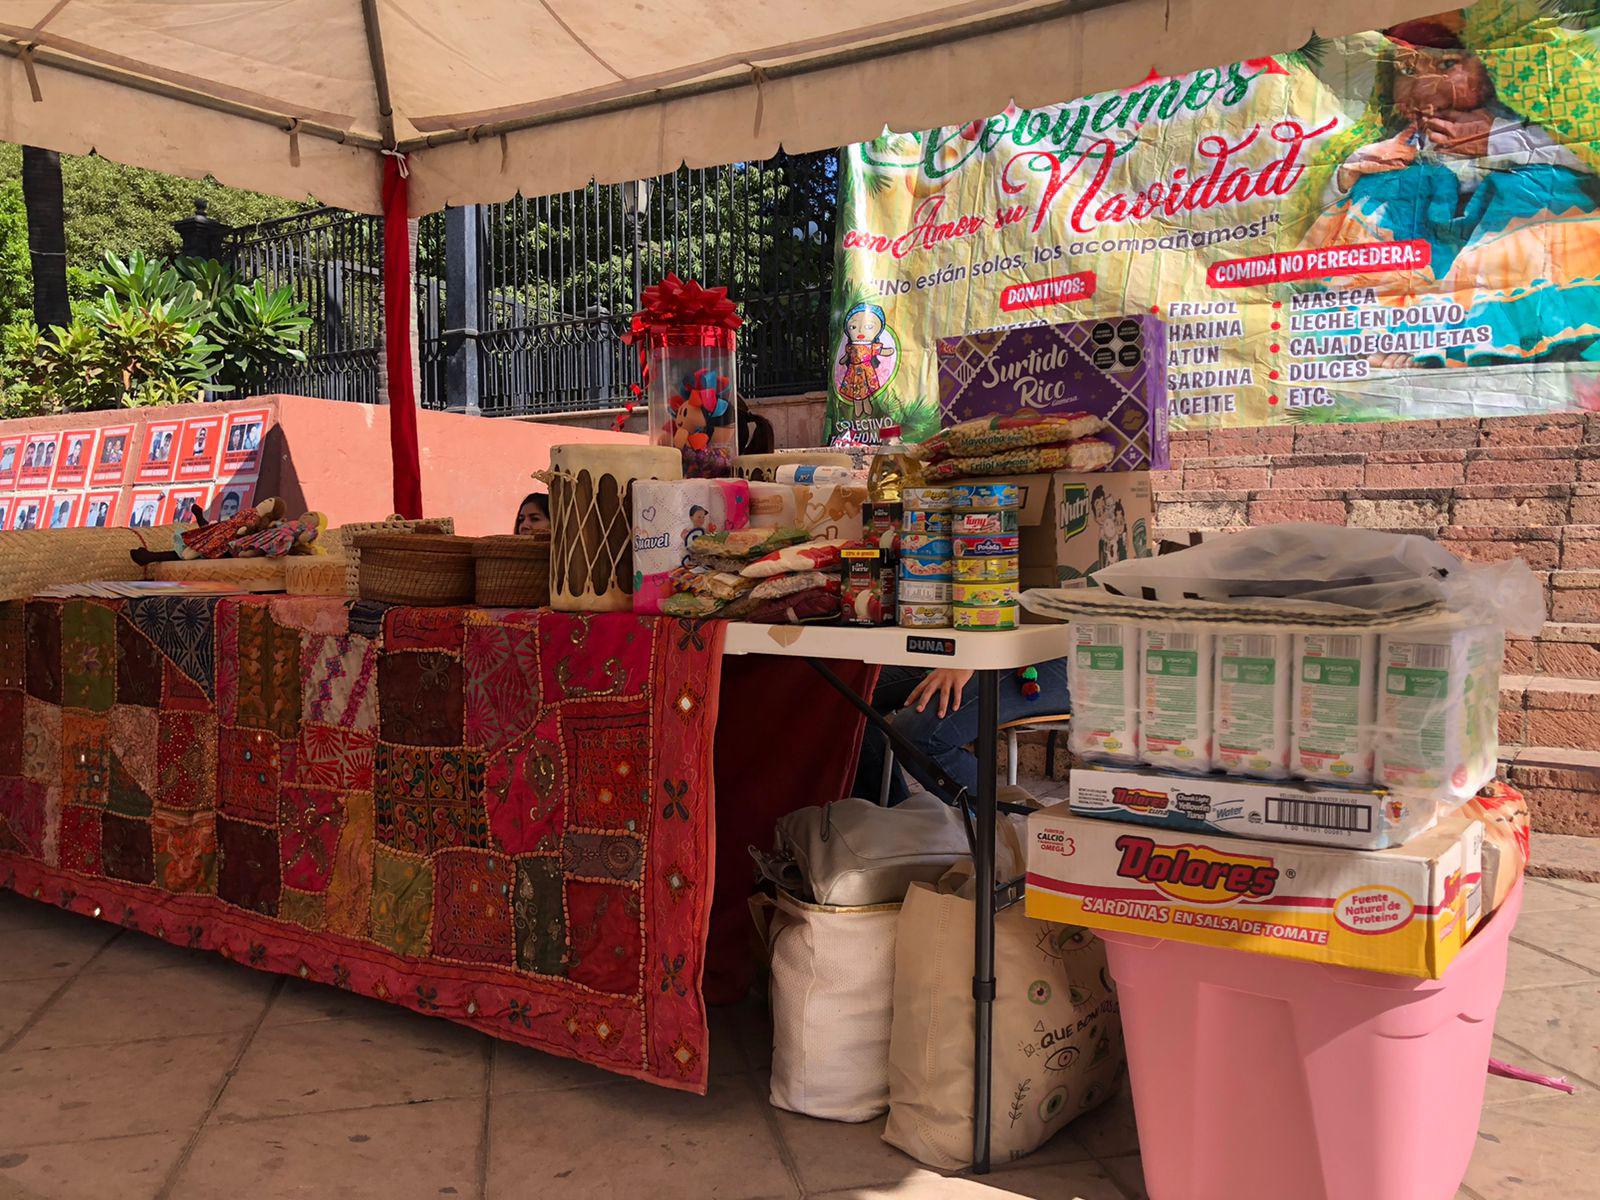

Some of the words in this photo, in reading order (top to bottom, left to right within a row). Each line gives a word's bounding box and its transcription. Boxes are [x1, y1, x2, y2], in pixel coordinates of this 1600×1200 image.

[1001, 117, 1338, 233] Navidad
[892, 195, 986, 258] Amor
[994, 204, 1029, 230] su
[843, 230, 893, 253] con
[916, 263, 966, 290] están
[972, 254, 1027, 277] solos,
[1034, 244, 1062, 264] los
[1215, 261, 1277, 283] COMIDA
[1280, 256, 1304, 273] NO
[1307, 245, 1422, 271] PERECEDERA:
[1007, 278, 1085, 305] DONATIVOS:
[1291, 288, 1376, 310] MASECA
[1168, 301, 1238, 317] FRIJOL
[1291, 311, 1357, 331] LECHE
[1361, 310, 1389, 328] EN
[1392, 304, 1464, 326] POLVO
[1168, 320, 1243, 342] HARINA
[1290, 335, 1343, 356] CAJA
[1344, 333, 1375, 352] DE
[1378, 325, 1490, 352] GALLETAS
[982, 344, 1069, 389] Surtido
[1168, 346, 1219, 366] ATUN
[1167, 369, 1253, 391] SARDINA
[1289, 361, 1368, 382] DULCES
[1012, 375, 1067, 409] Rico
[1289, 387, 1333, 408] ETC.
[1168, 395, 1235, 416] ACEITE
[835, 416, 893, 433] COLECTIVO
[970, 459, 994, 473] Frijol
[1060, 489, 1090, 530] Nutri
[965, 515, 988, 528] Tuny
[1112, 787, 1169, 809] Dolores
[1178, 801, 1211, 812] Yellowfin
[1147, 807, 1169, 816] tuna
[1186, 810, 1206, 820] Tuna
[1216, 806, 1243, 818] Water
[1037, 832, 1065, 842] CALCIO
[1040, 844, 1065, 853] OMEGA
[1061, 837, 1076, 857] 3
[1115, 834, 1280, 897] Dolores
[1345, 902, 1386, 916] Natural
[1387, 900, 1401, 911] de
[1351, 894, 1389, 905] Fuente
[1082, 896, 1170, 923] SARDINAS
[1174, 911, 1195, 926] EN
[1195, 913, 1240, 931] SALSA
[1241, 922, 1262, 936] DE
[1264, 924, 1329, 945] TOMATE
[1041, 1023, 1074, 1049] QUE
